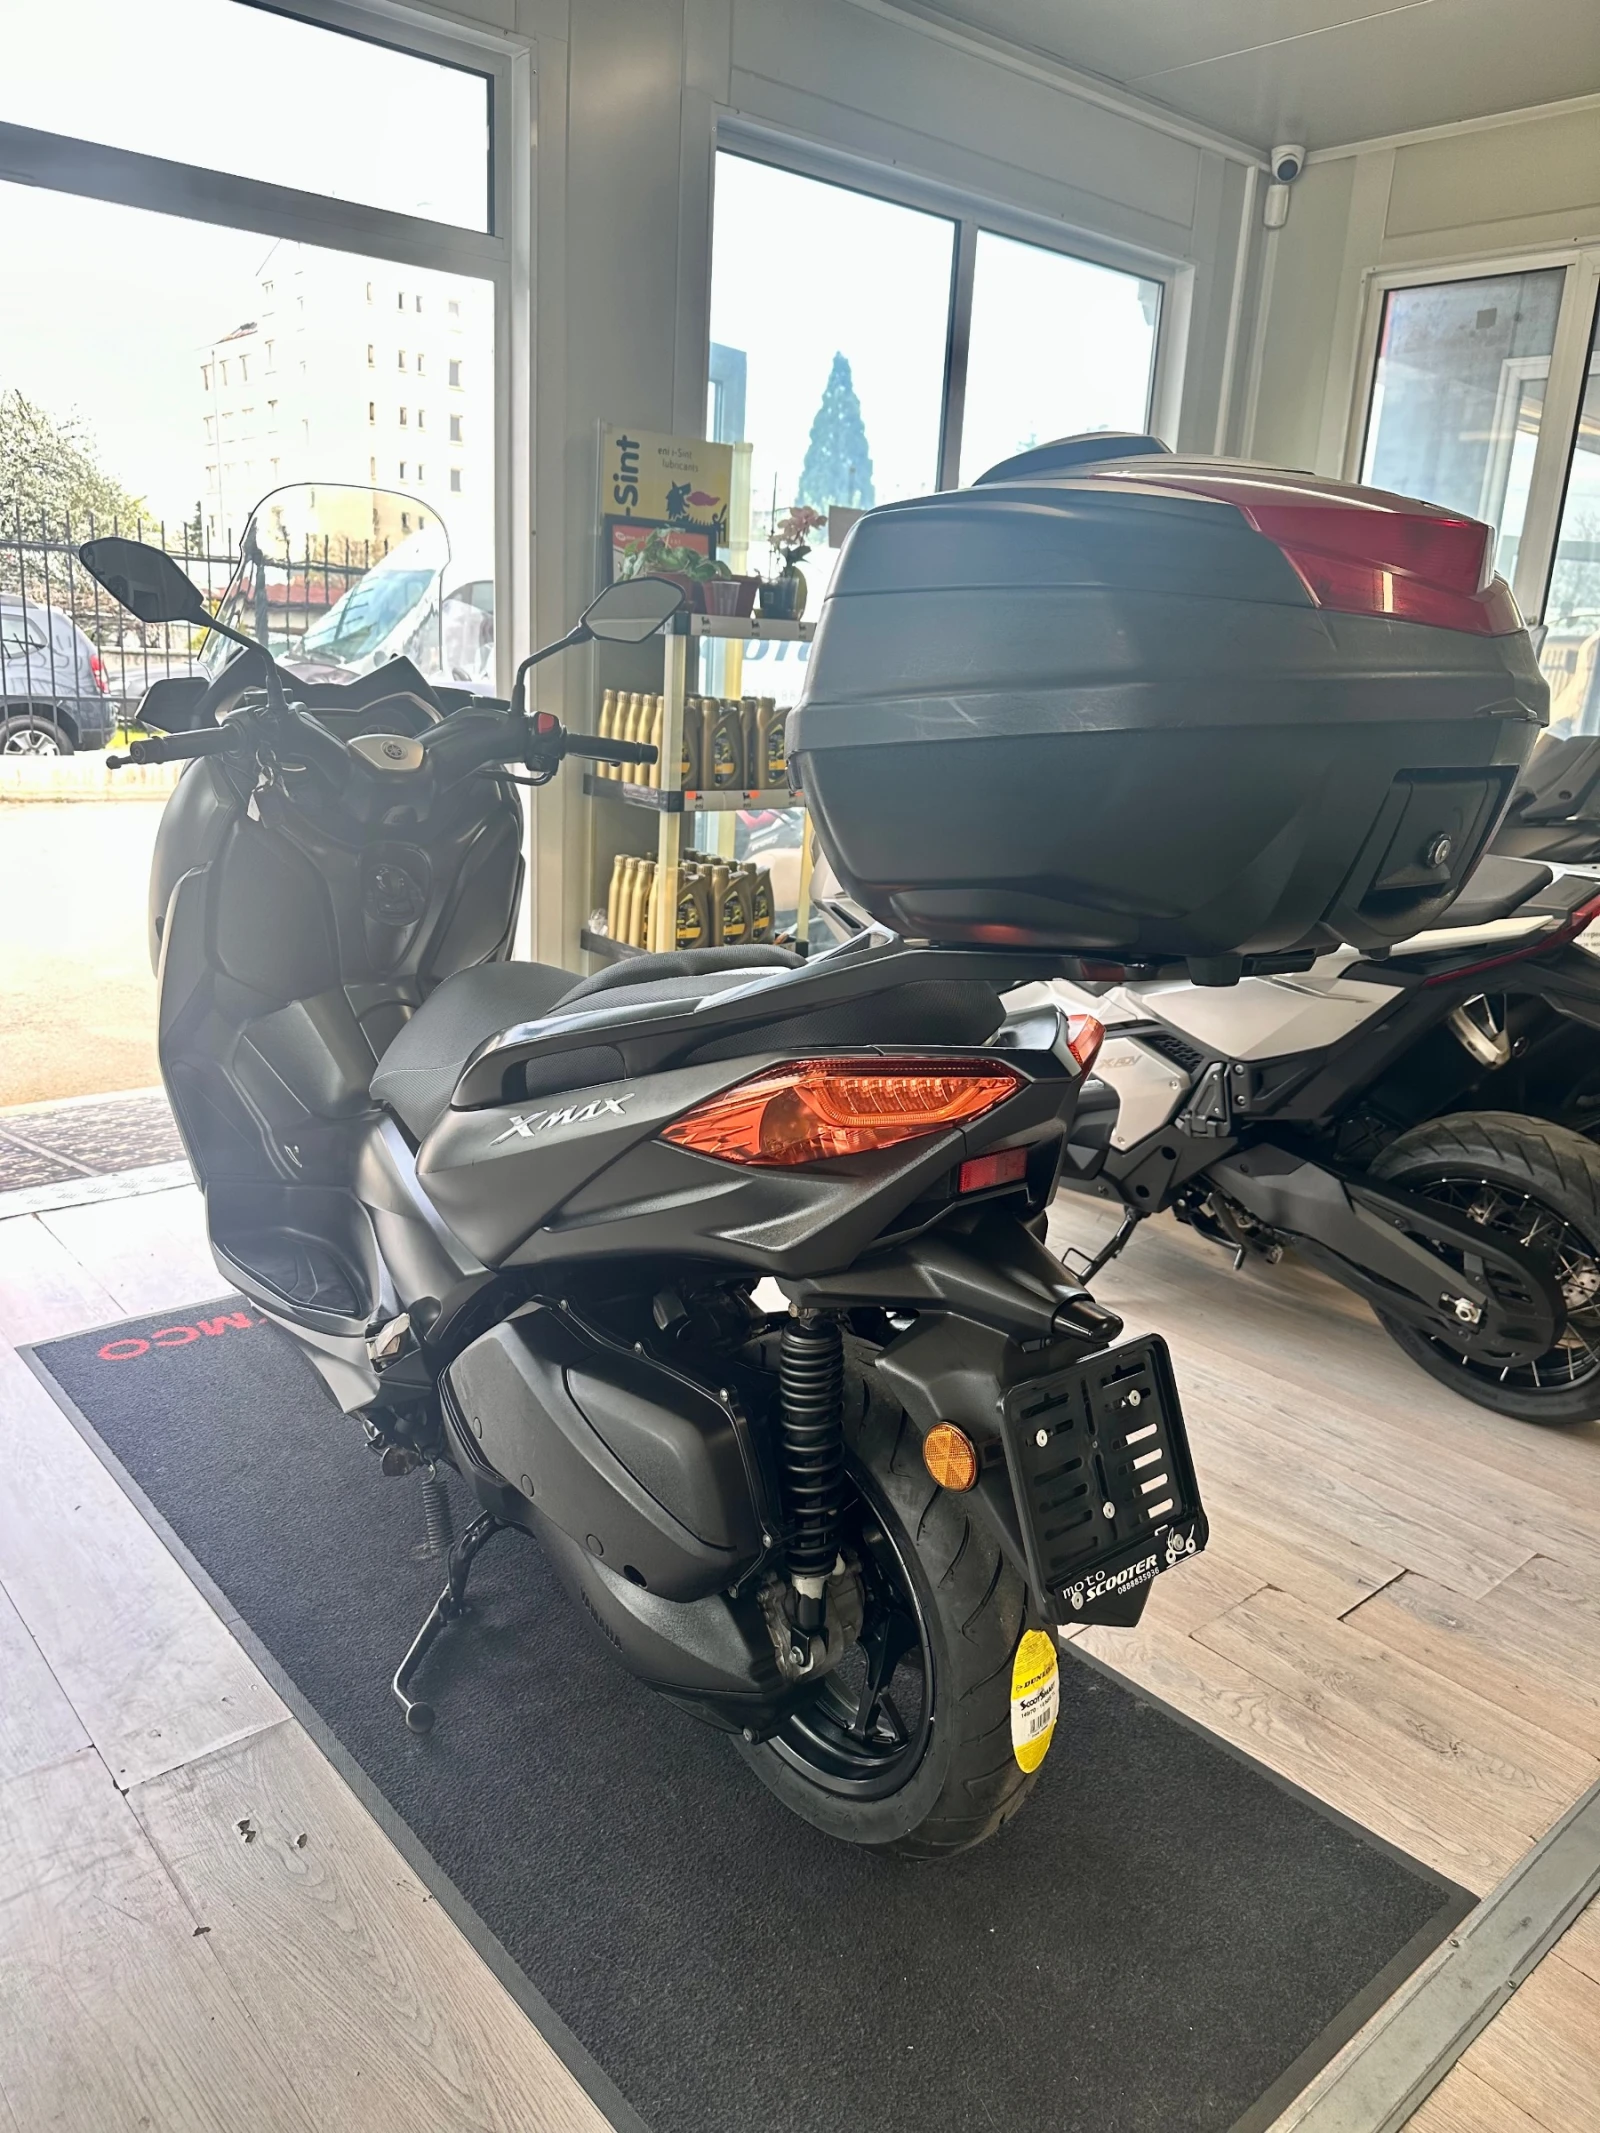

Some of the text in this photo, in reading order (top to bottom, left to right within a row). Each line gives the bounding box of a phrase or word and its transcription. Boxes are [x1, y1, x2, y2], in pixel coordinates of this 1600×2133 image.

[662, 458, 699, 473] lubricants
[1062, 1570, 1106, 1600] moto
[1086, 1554, 1158, 1602] SCOOTER
